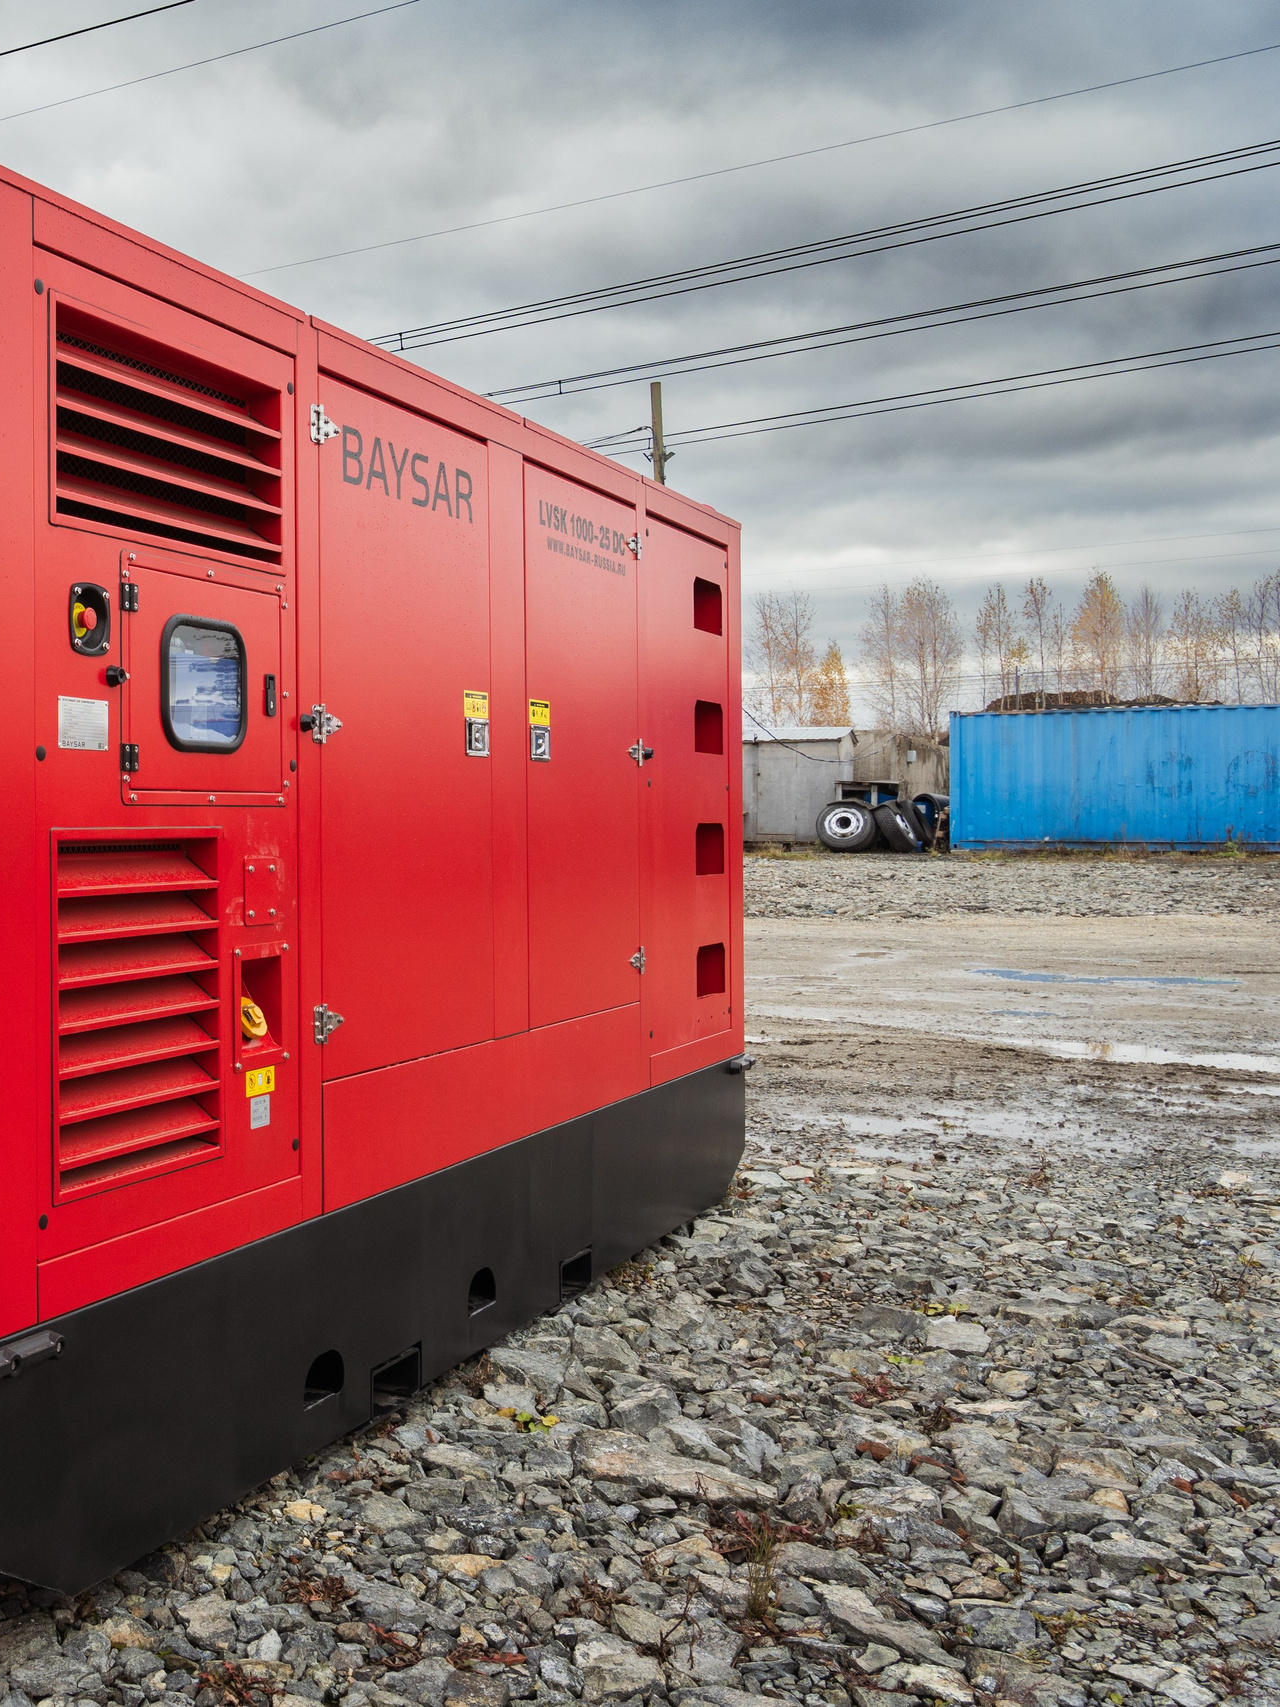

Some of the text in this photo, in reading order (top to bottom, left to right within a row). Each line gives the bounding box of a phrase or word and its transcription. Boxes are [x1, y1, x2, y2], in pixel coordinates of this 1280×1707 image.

[342, 424, 473, 524] BAYSAR
[539, 499, 626, 557] LVSK 1000-25 DC
[546, 535, 626, 577] WWW.BAYSAR-RUSSIA.RU
[62, 740, 86, 748] BAYSAR
